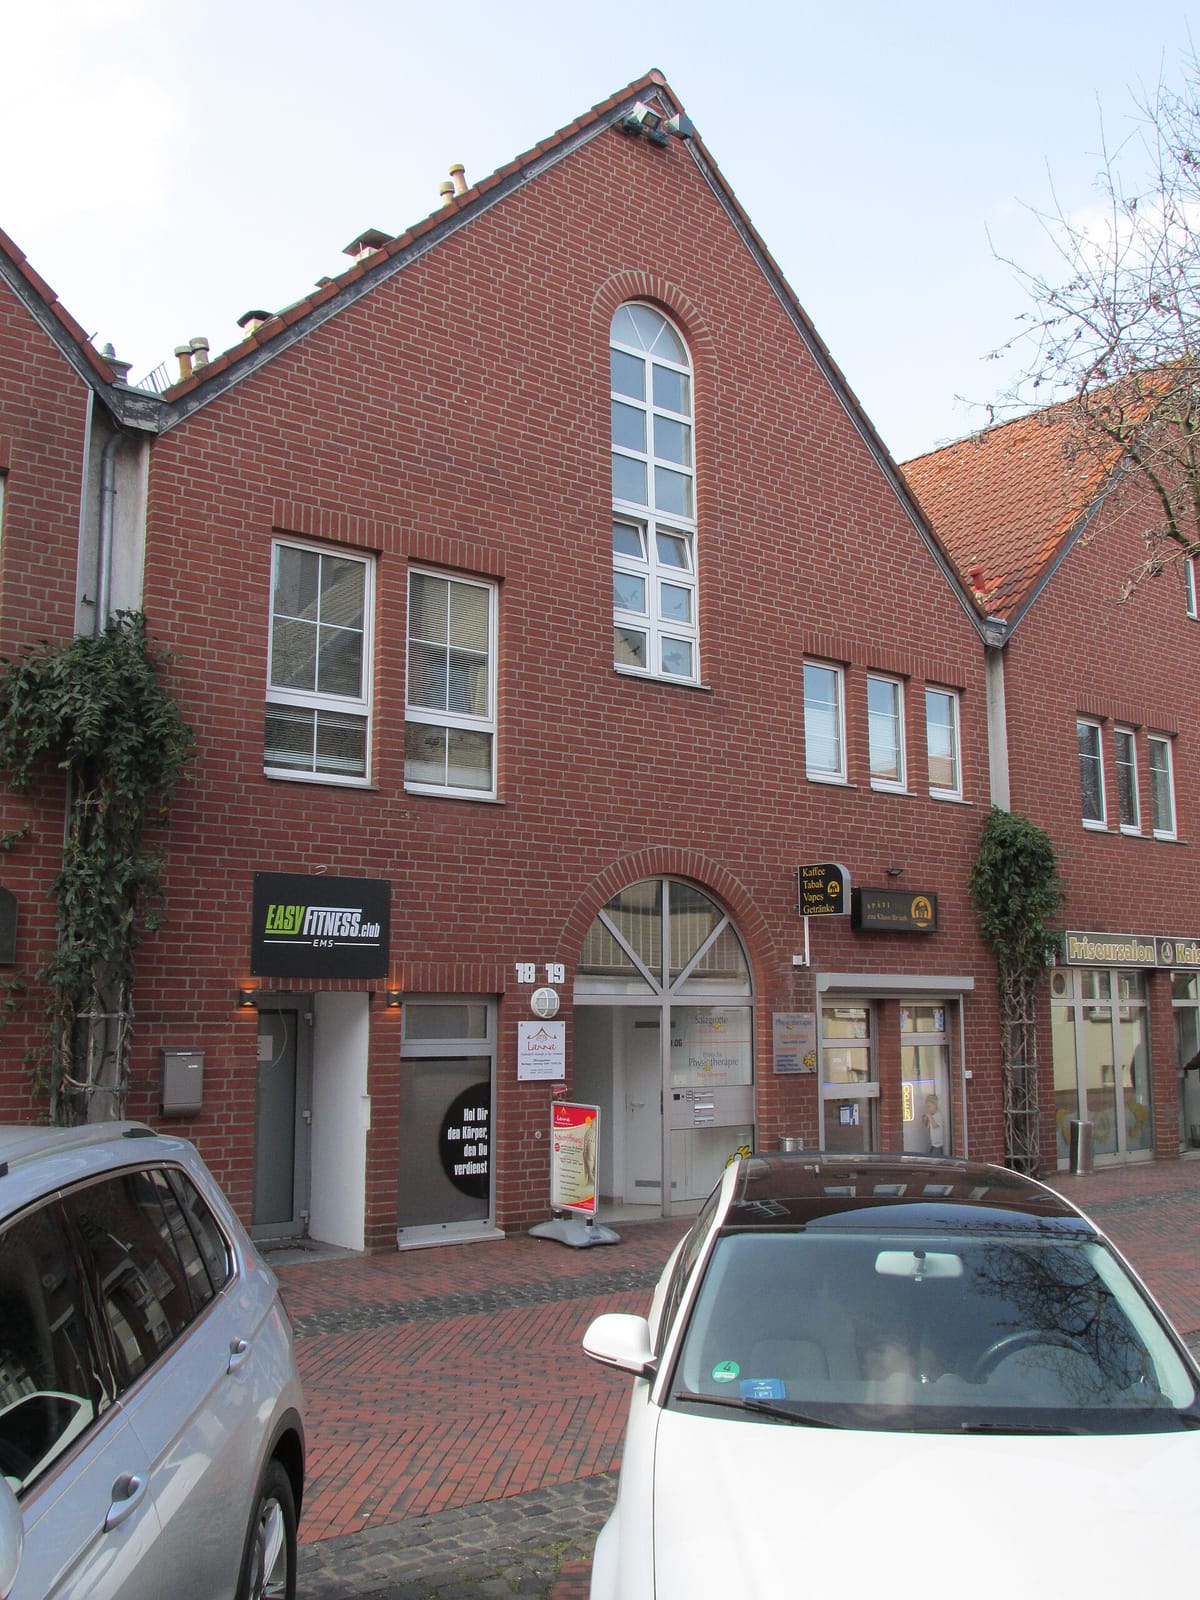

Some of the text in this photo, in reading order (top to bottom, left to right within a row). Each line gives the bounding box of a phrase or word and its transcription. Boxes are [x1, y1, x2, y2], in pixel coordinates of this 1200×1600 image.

[802, 866, 826, 877] Kaffee
[803, 880, 824, 889] Tabak
[803, 893, 824, 902] Vapes
[803, 904, 835, 914] Getränke
[312, 939, 334, 948] EMS
[1069, 936, 1155, 962] Friseursalon
[515, 962, 565, 984] 18 19
[463, 1107, 488, 1121] Hol Dir
[447, 1126, 461, 1140] den
[464, 1143, 488, 1157] den Du
[454, 1161, 488, 1176] verdienst
[723, 1362, 731, 1371] 4
